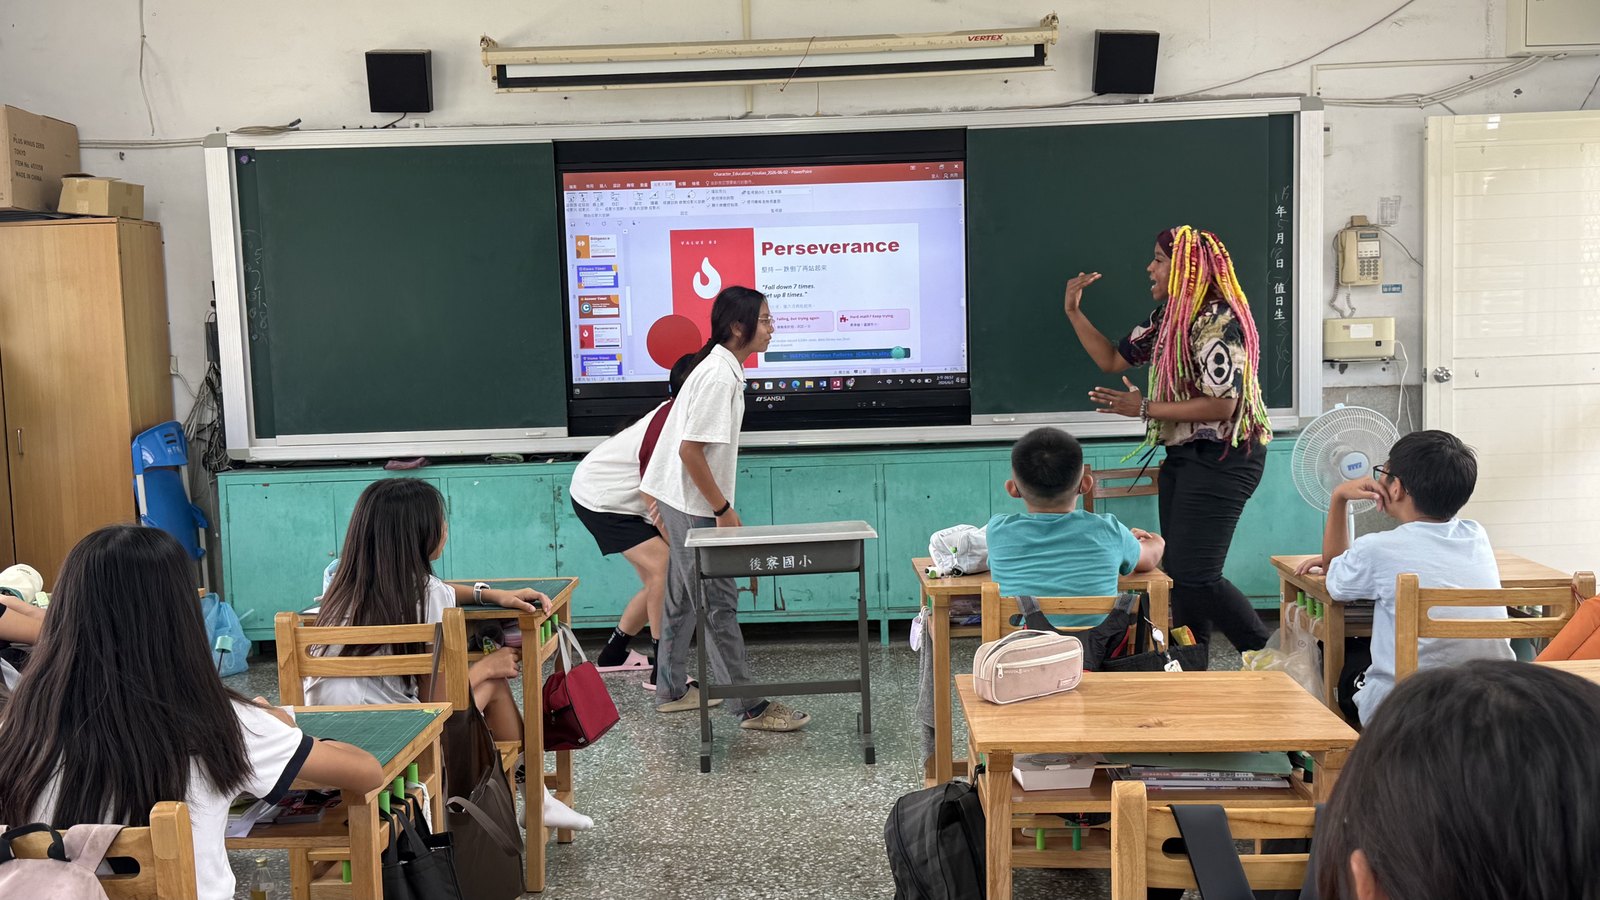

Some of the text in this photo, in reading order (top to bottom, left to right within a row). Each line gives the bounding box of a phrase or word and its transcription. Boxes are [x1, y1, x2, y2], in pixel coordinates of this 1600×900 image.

[967, 34, 1003, 42] VERTEX
[1274, 204, 1288, 218] 年
[1274, 232, 1284, 245] 月
[761, 241, 900, 256] Perseverance
[1276, 258, 1284, 268] 日
[1273, 282, 1286, 320] 值日生
[749, 554, 812, 571] 後寮國小
